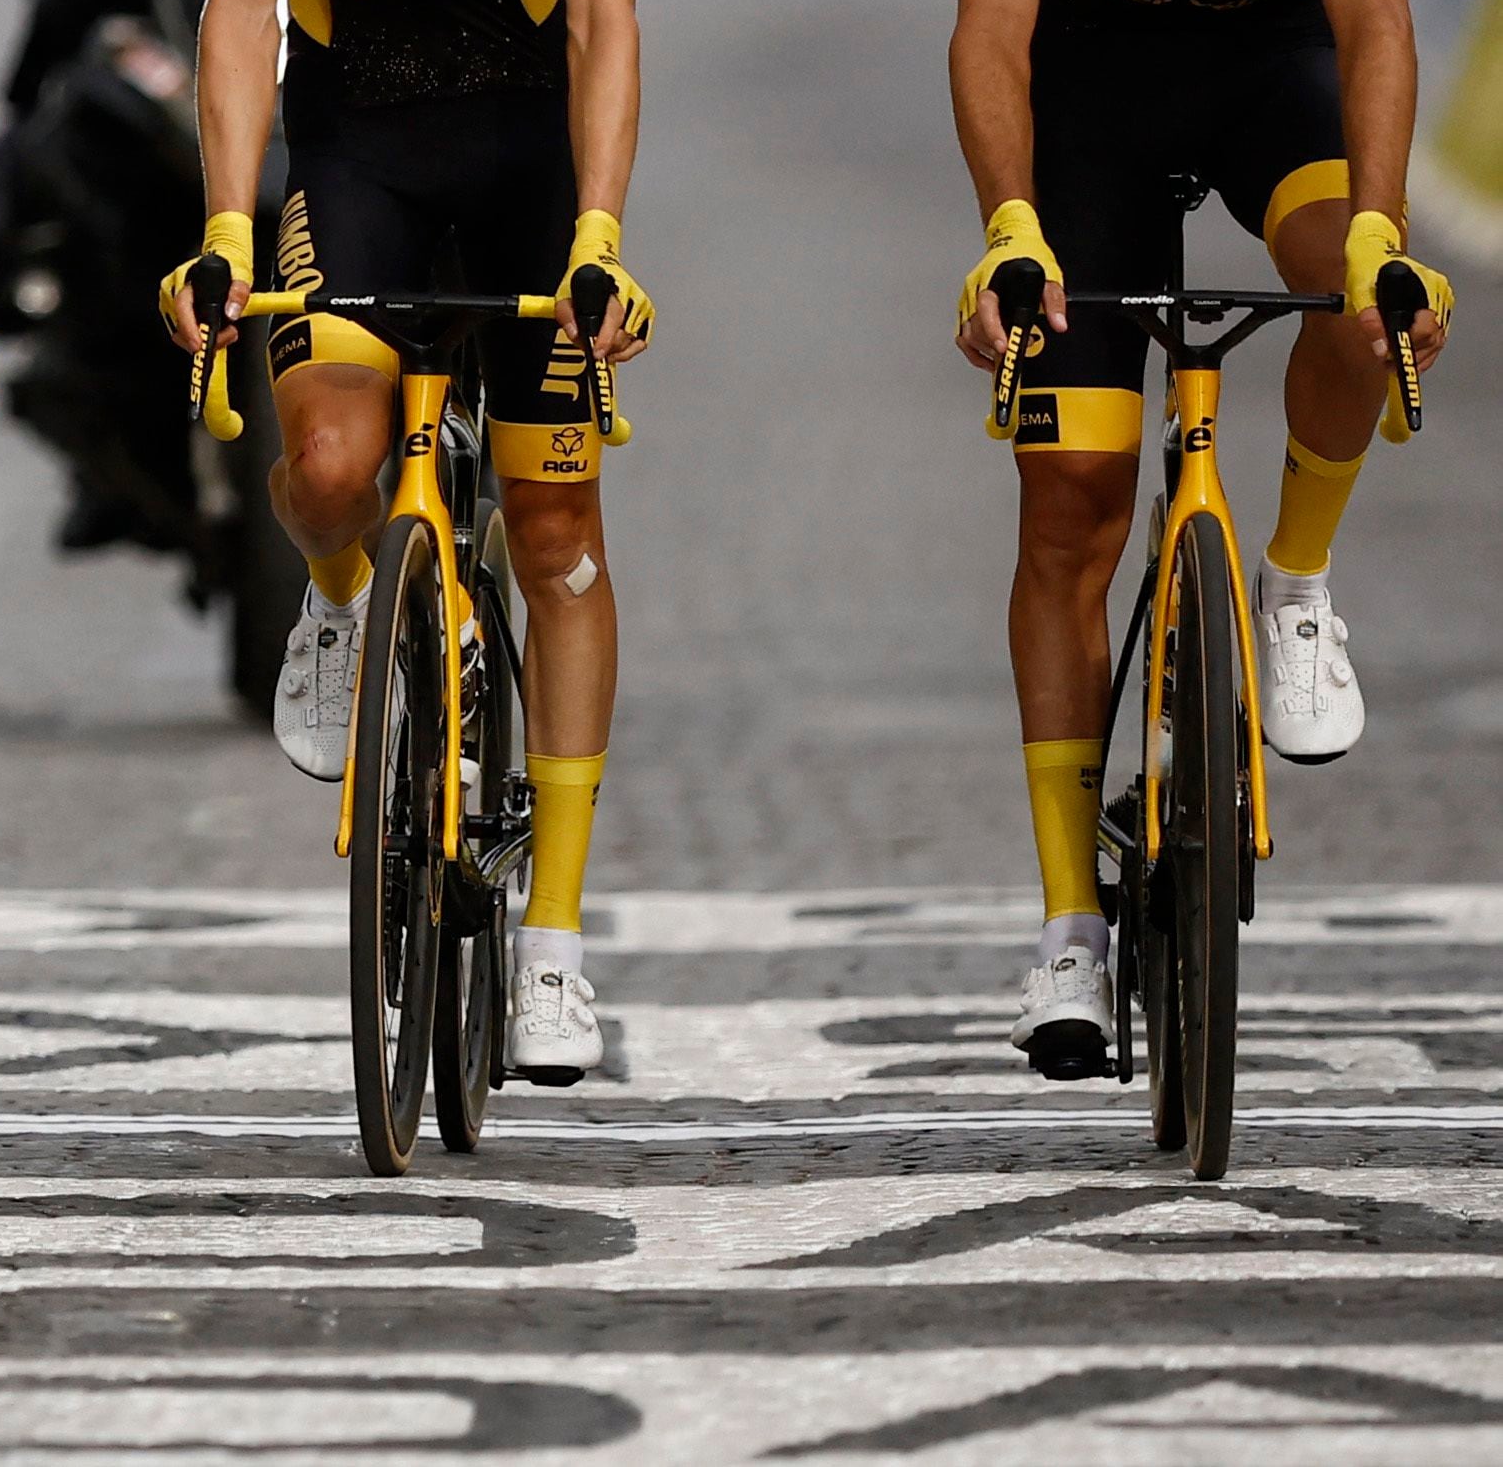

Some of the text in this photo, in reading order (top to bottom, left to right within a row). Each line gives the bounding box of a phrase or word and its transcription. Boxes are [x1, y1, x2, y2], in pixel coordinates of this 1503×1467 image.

[1121, 296, 1175, 305] cervélo
[190, 323, 210, 407] SRAM
[273, 336, 307, 363] HEMA
[998, 326, 1023, 405] SRAM
[1398, 330, 1421, 409] SRAM
[542, 459, 588, 474] AGU
